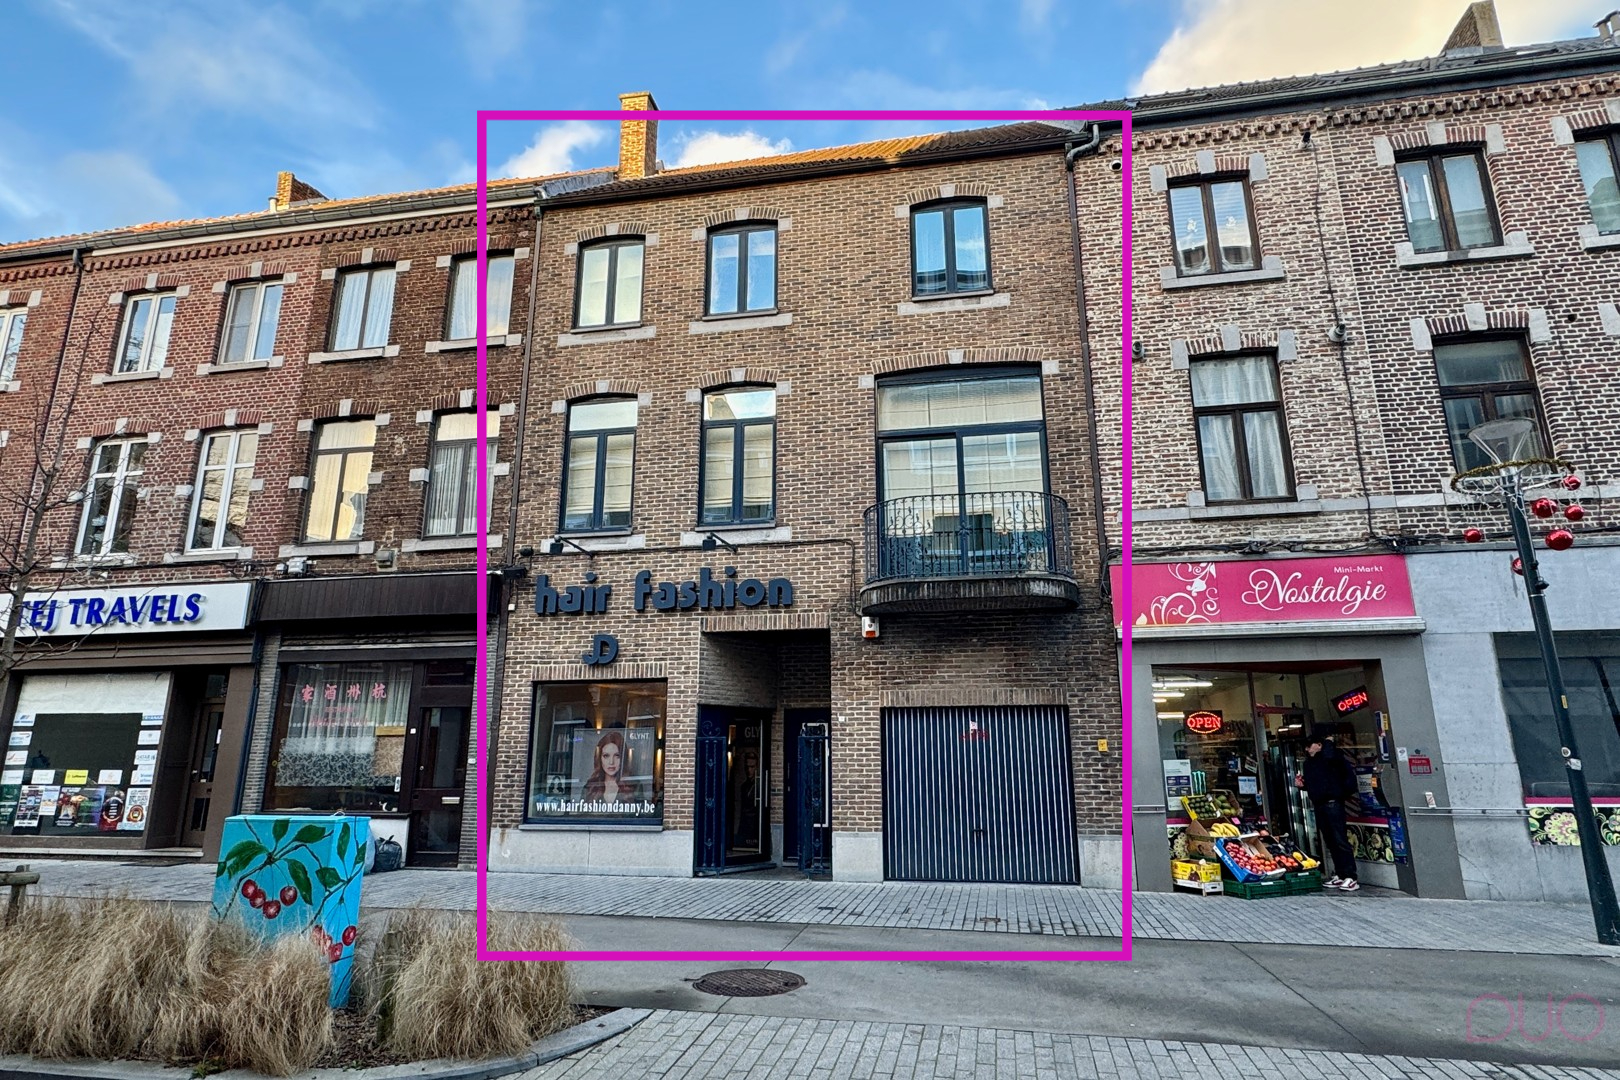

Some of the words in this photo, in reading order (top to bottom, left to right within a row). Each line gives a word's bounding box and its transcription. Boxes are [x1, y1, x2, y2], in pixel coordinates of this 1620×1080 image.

[1333, 565, 1384, 574] Mini-Markt
[534, 571, 613, 616] hair
[634, 566, 794, 612] fashion
[1241, 568, 1387, 615] Nostalgie
[69, 593, 203, 626] TRAVELS
[582, 633, 620, 666] JD
[1337, 692, 1368, 711] OPEN
[1186, 718, 1222, 729] OPEN
[629, 732, 650, 741] GLYNT
[536, 799, 656, 816] www.hairfashiondanny.be
